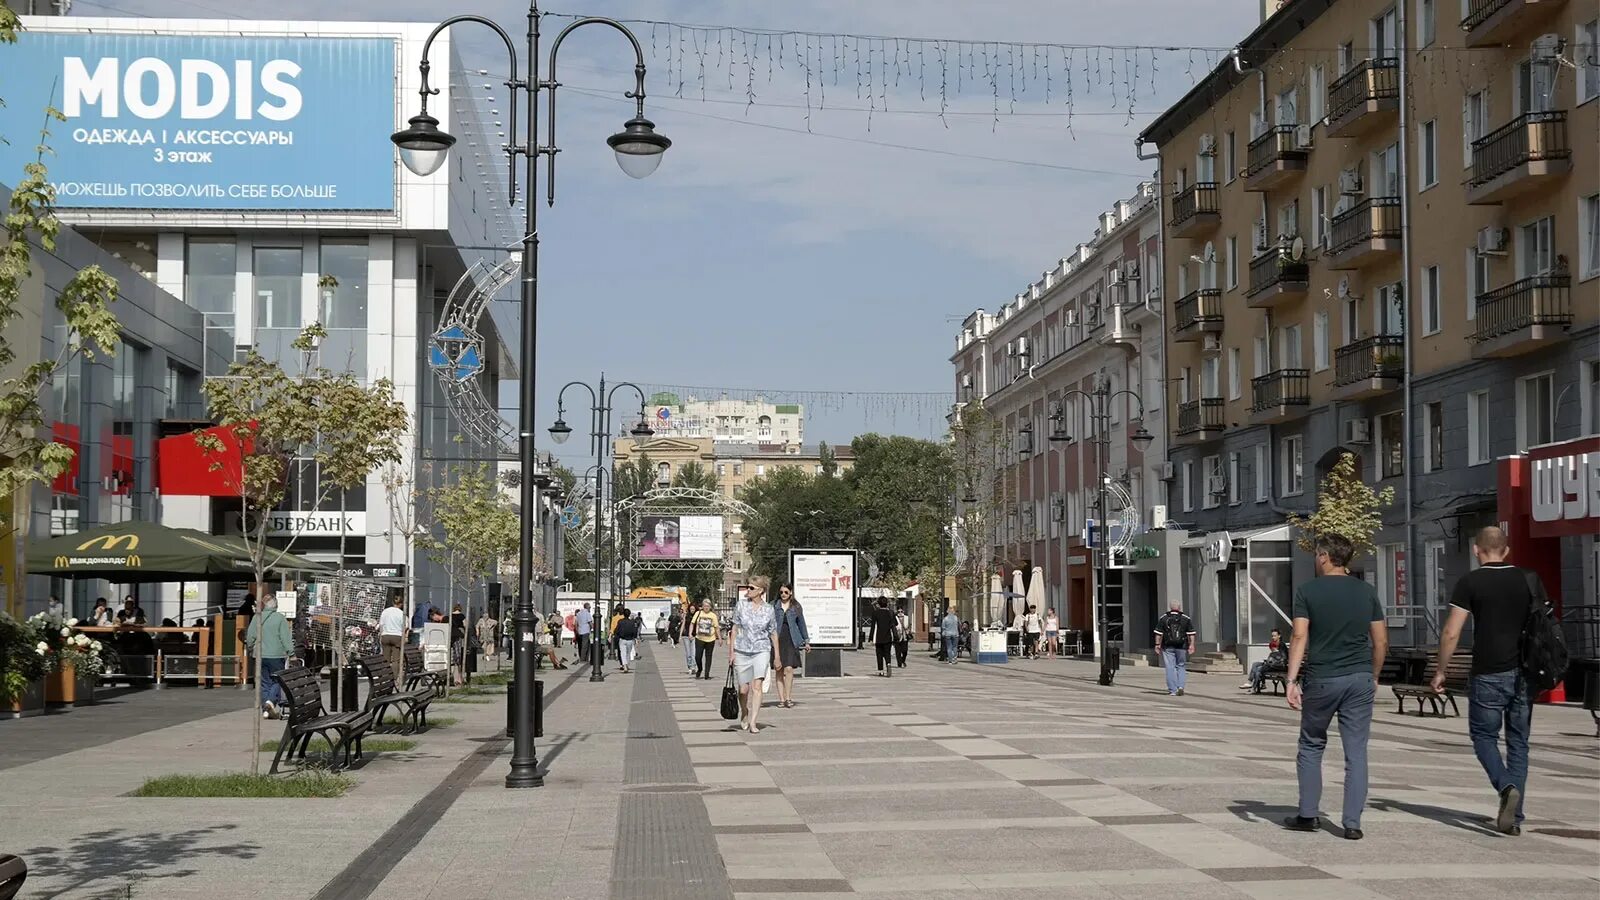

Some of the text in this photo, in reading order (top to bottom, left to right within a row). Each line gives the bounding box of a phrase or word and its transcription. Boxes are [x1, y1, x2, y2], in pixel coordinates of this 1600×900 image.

[63, 56, 303, 121] MODIS
[73, 128, 156, 146] ОДЕЖДА
[173, 130, 293, 146] АКСЕССУАРЫ
[153, 148, 213, 163] 3 этаж
[51, 181, 337, 199] МОЖЕШЬ ПОЗВОЛИТЬ СЕБЕ БОЛЬШЕ
